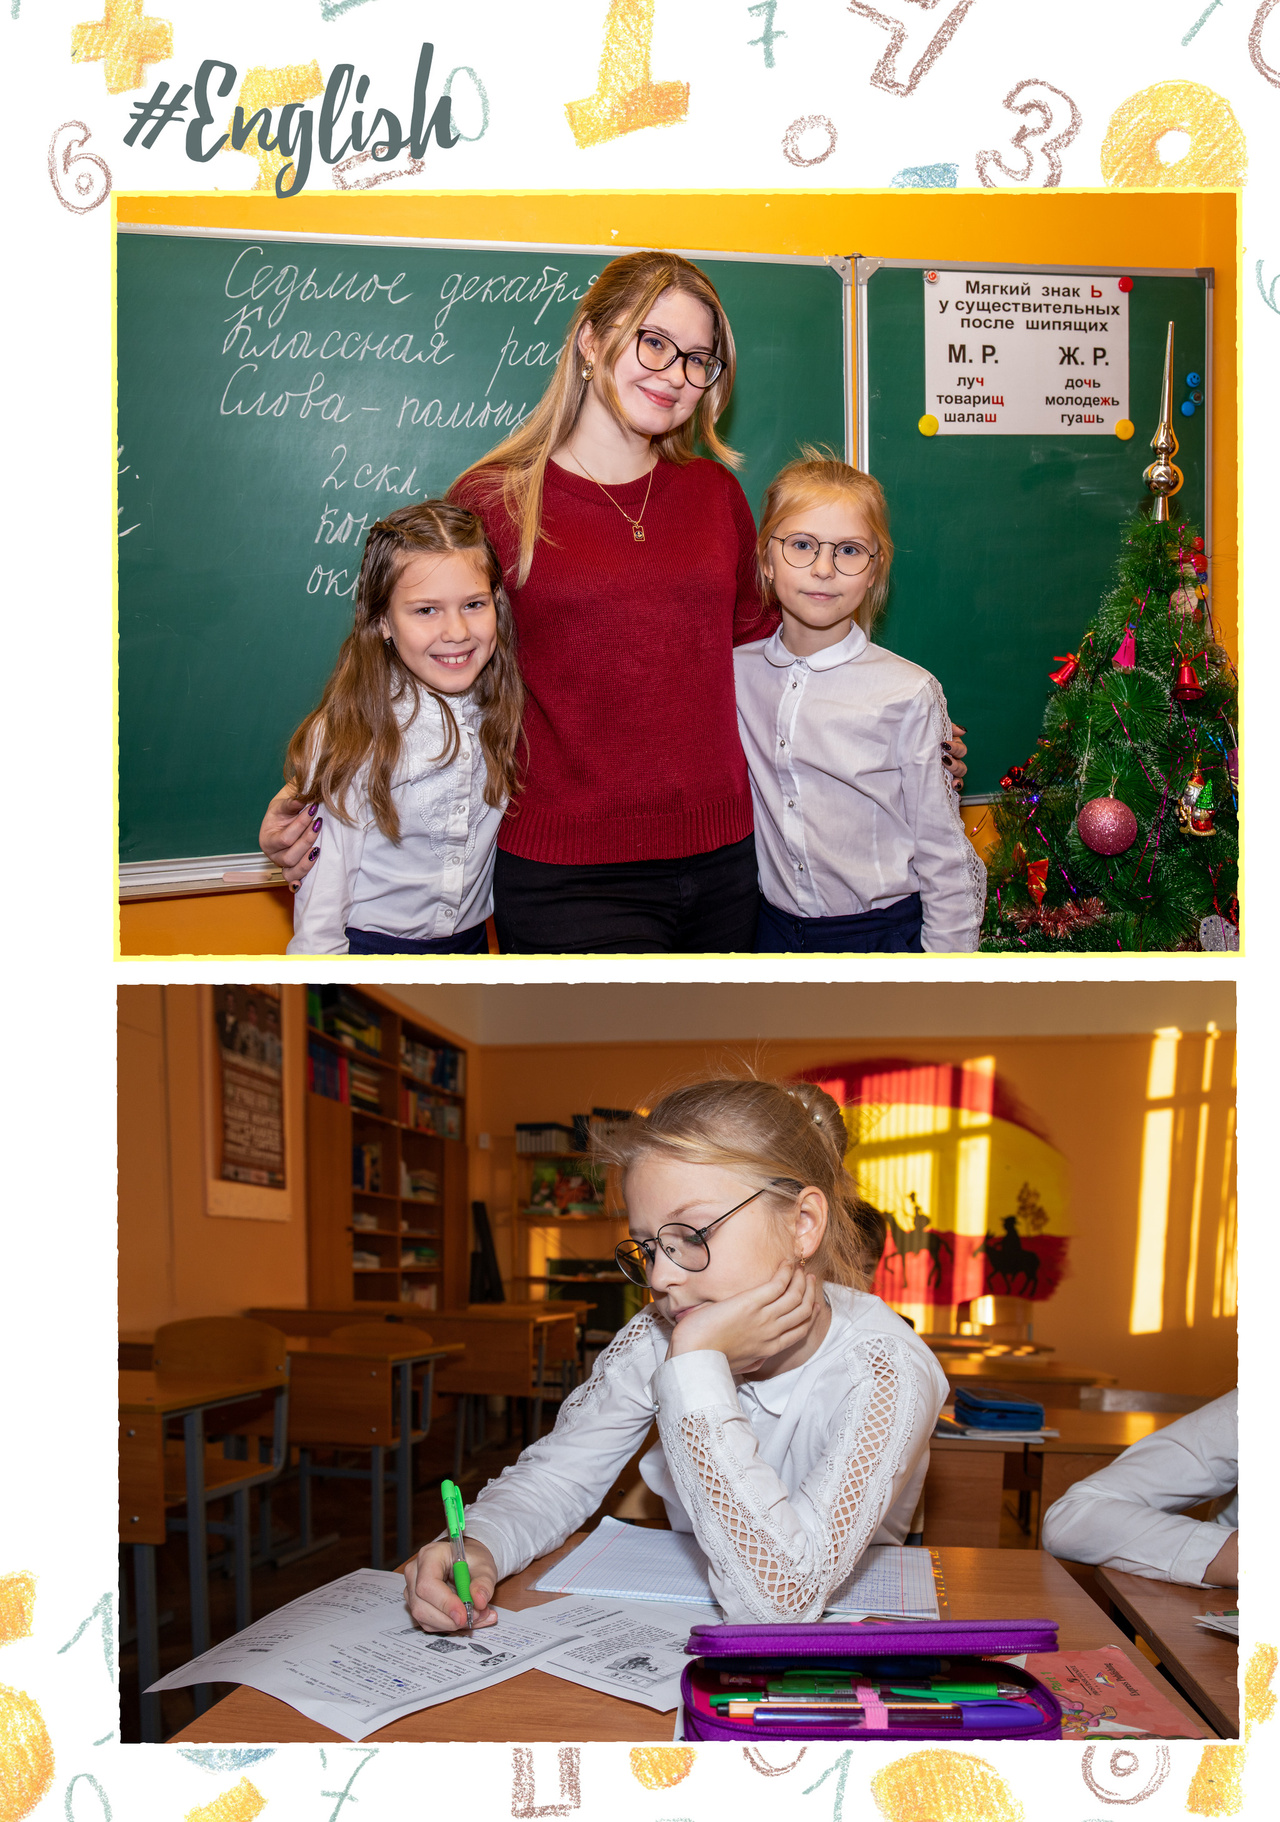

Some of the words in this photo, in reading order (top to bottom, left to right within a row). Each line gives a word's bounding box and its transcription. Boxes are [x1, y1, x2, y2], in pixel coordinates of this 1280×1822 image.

[225, 246, 414, 328] Седьмое
[966, 280, 1031, 296] Мягкий
[1041, 285, 1081, 298] знак
[939, 300, 949, 314] у
[955, 299, 1120, 316] существительных
[222, 304, 456, 364] Классная
[960, 317, 1015, 330] после
[1025, 319, 1109, 334] шипящих
[948, 344, 973, 364] М.
[981, 344, 999, 364] Р.
[1058, 346, 1085, 366] Ж.
[1092, 347, 1110, 366] Р.
[956, 377, 984, 390] луч
[1064, 378, 1101, 390] дочь
[936, 394, 1004, 407] товарищ
[1045, 396, 1120, 408] молодежь
[944, 412, 997, 423] шалаш
[1060, 413, 1105, 427] гуашь
